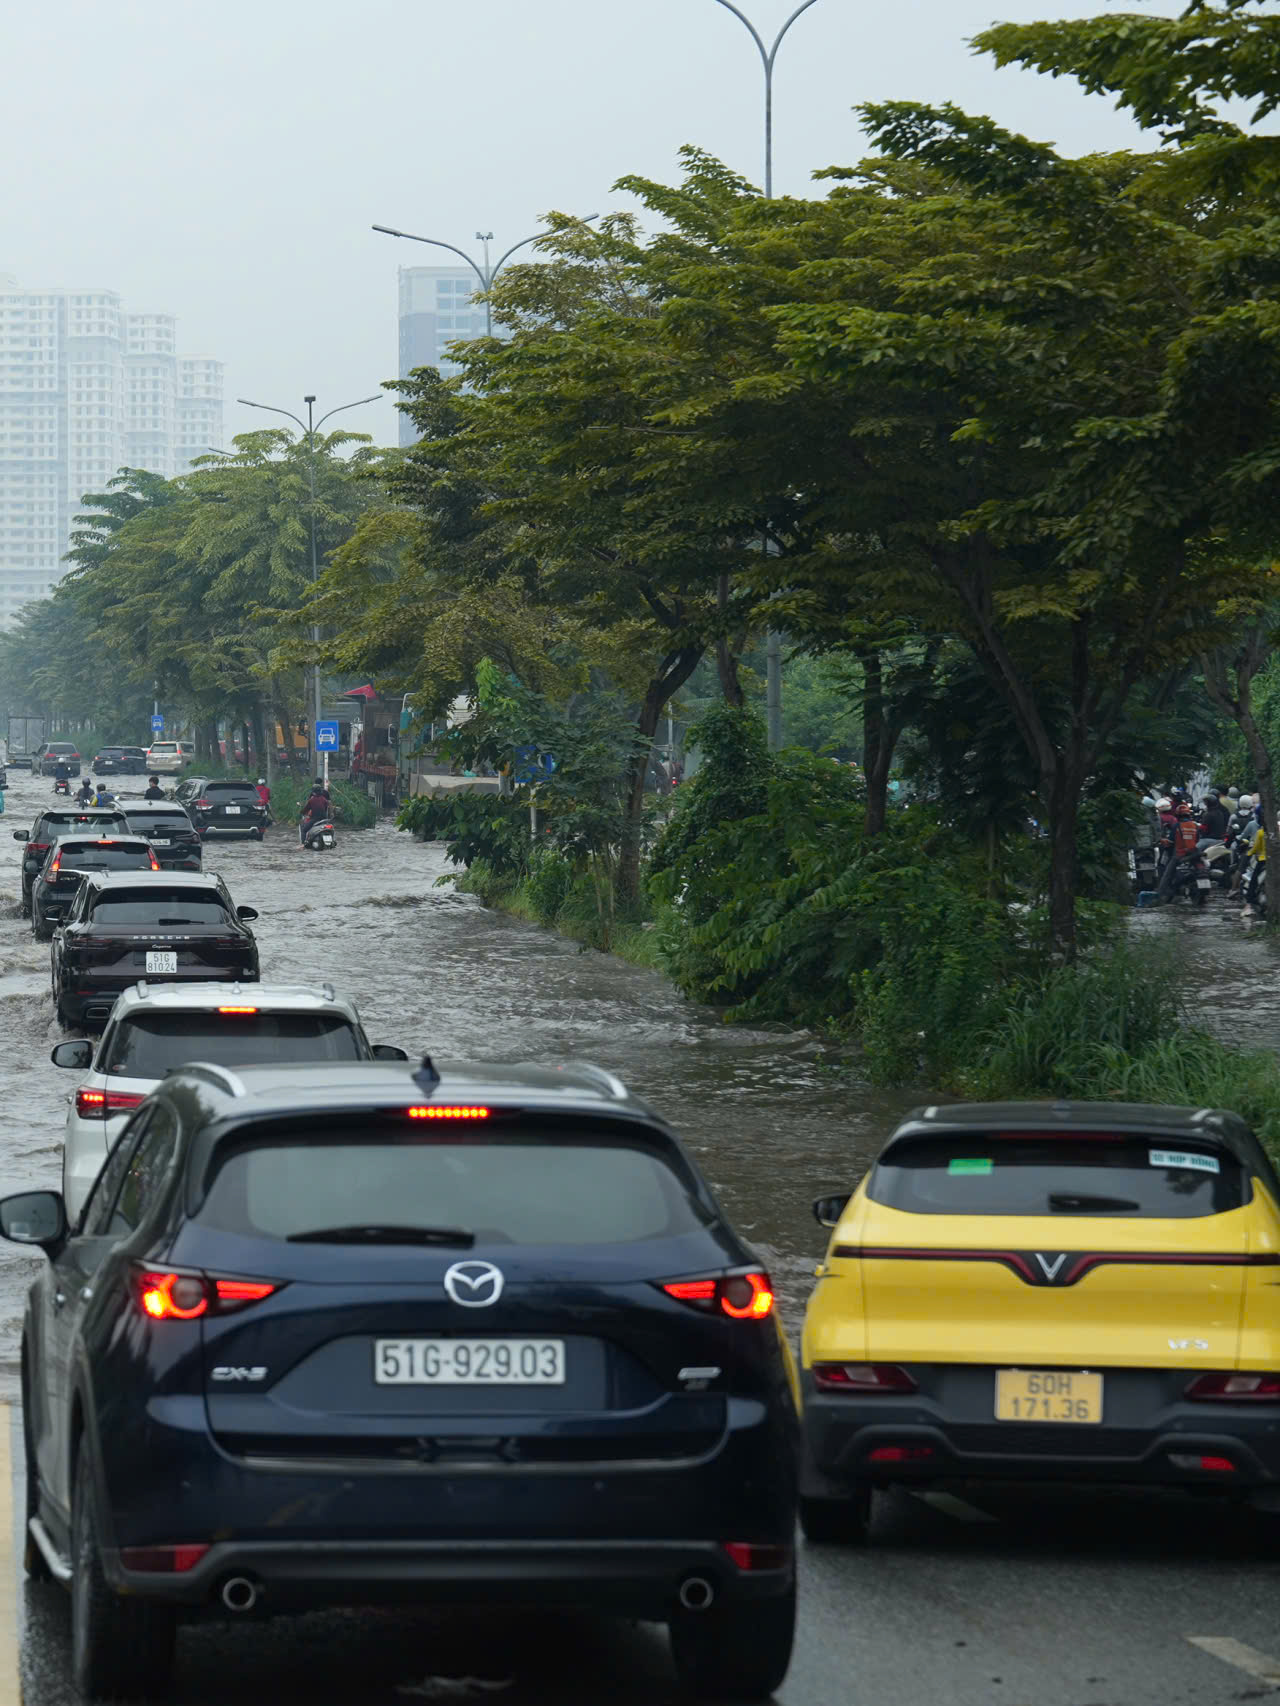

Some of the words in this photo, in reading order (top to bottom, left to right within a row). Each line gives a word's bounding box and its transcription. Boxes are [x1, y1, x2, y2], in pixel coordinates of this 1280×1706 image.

[153, 953, 170, 963] 51G
[382, 1344, 557, 1378] 51G-929.03
[1027, 1374, 1072, 1395] 60H
[1011, 1397, 1089, 1419] 171.36
